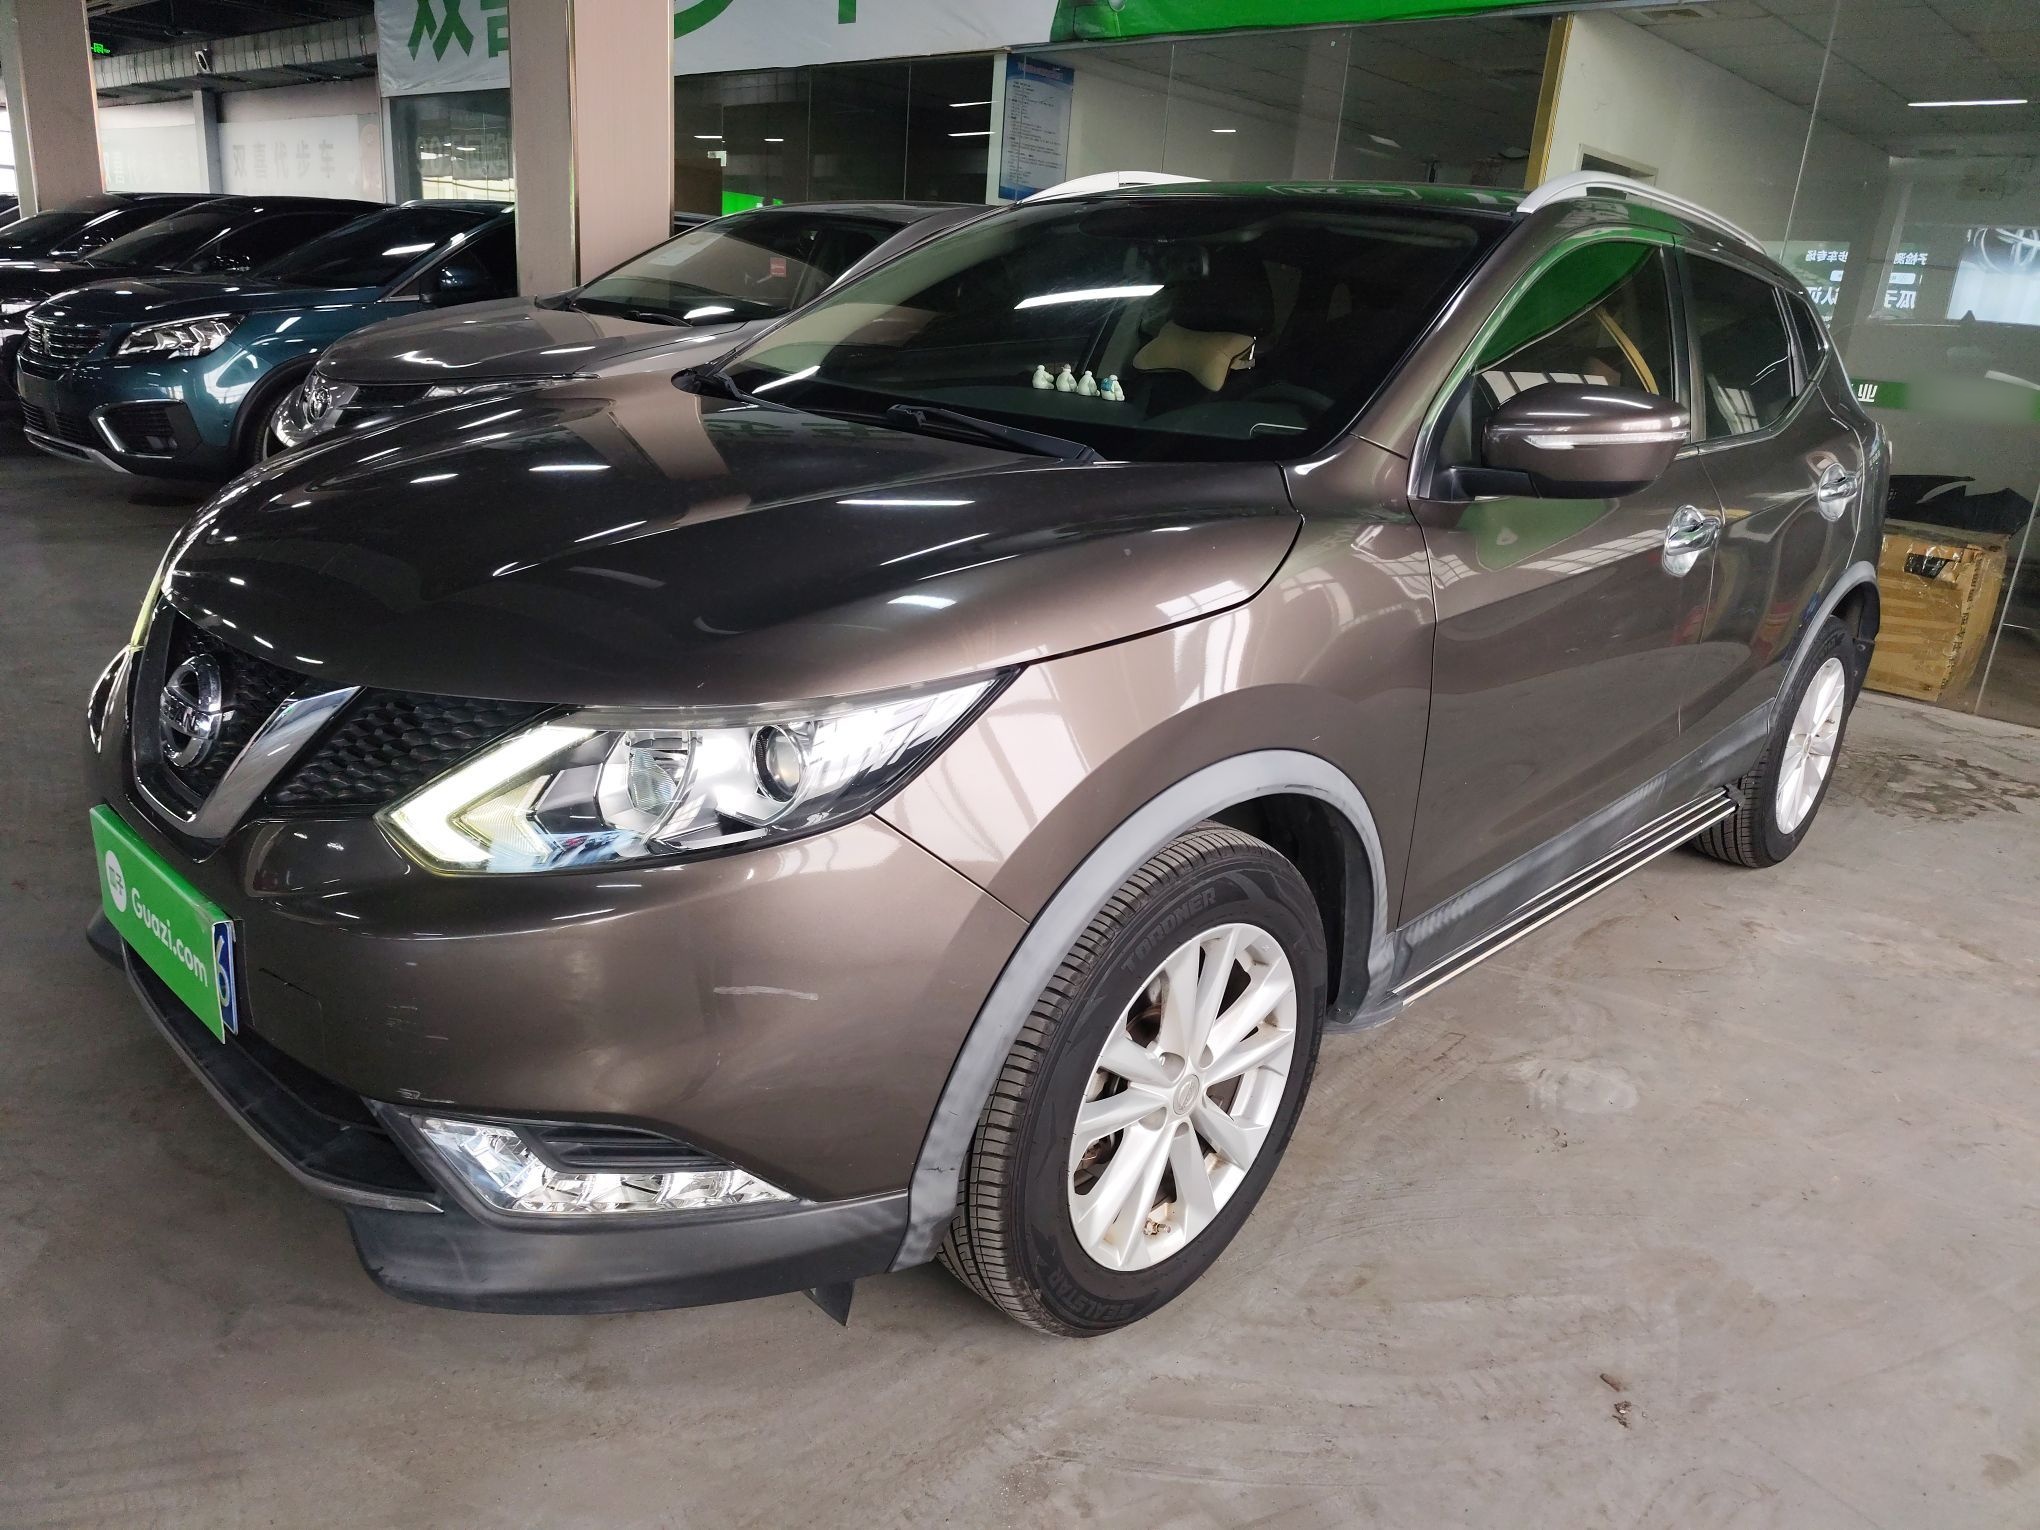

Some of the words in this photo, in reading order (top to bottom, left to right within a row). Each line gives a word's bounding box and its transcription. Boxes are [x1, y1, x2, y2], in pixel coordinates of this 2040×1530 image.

[232, 139, 336, 179] 双喜代步车
[131, 887, 208, 988] Guazi.com
